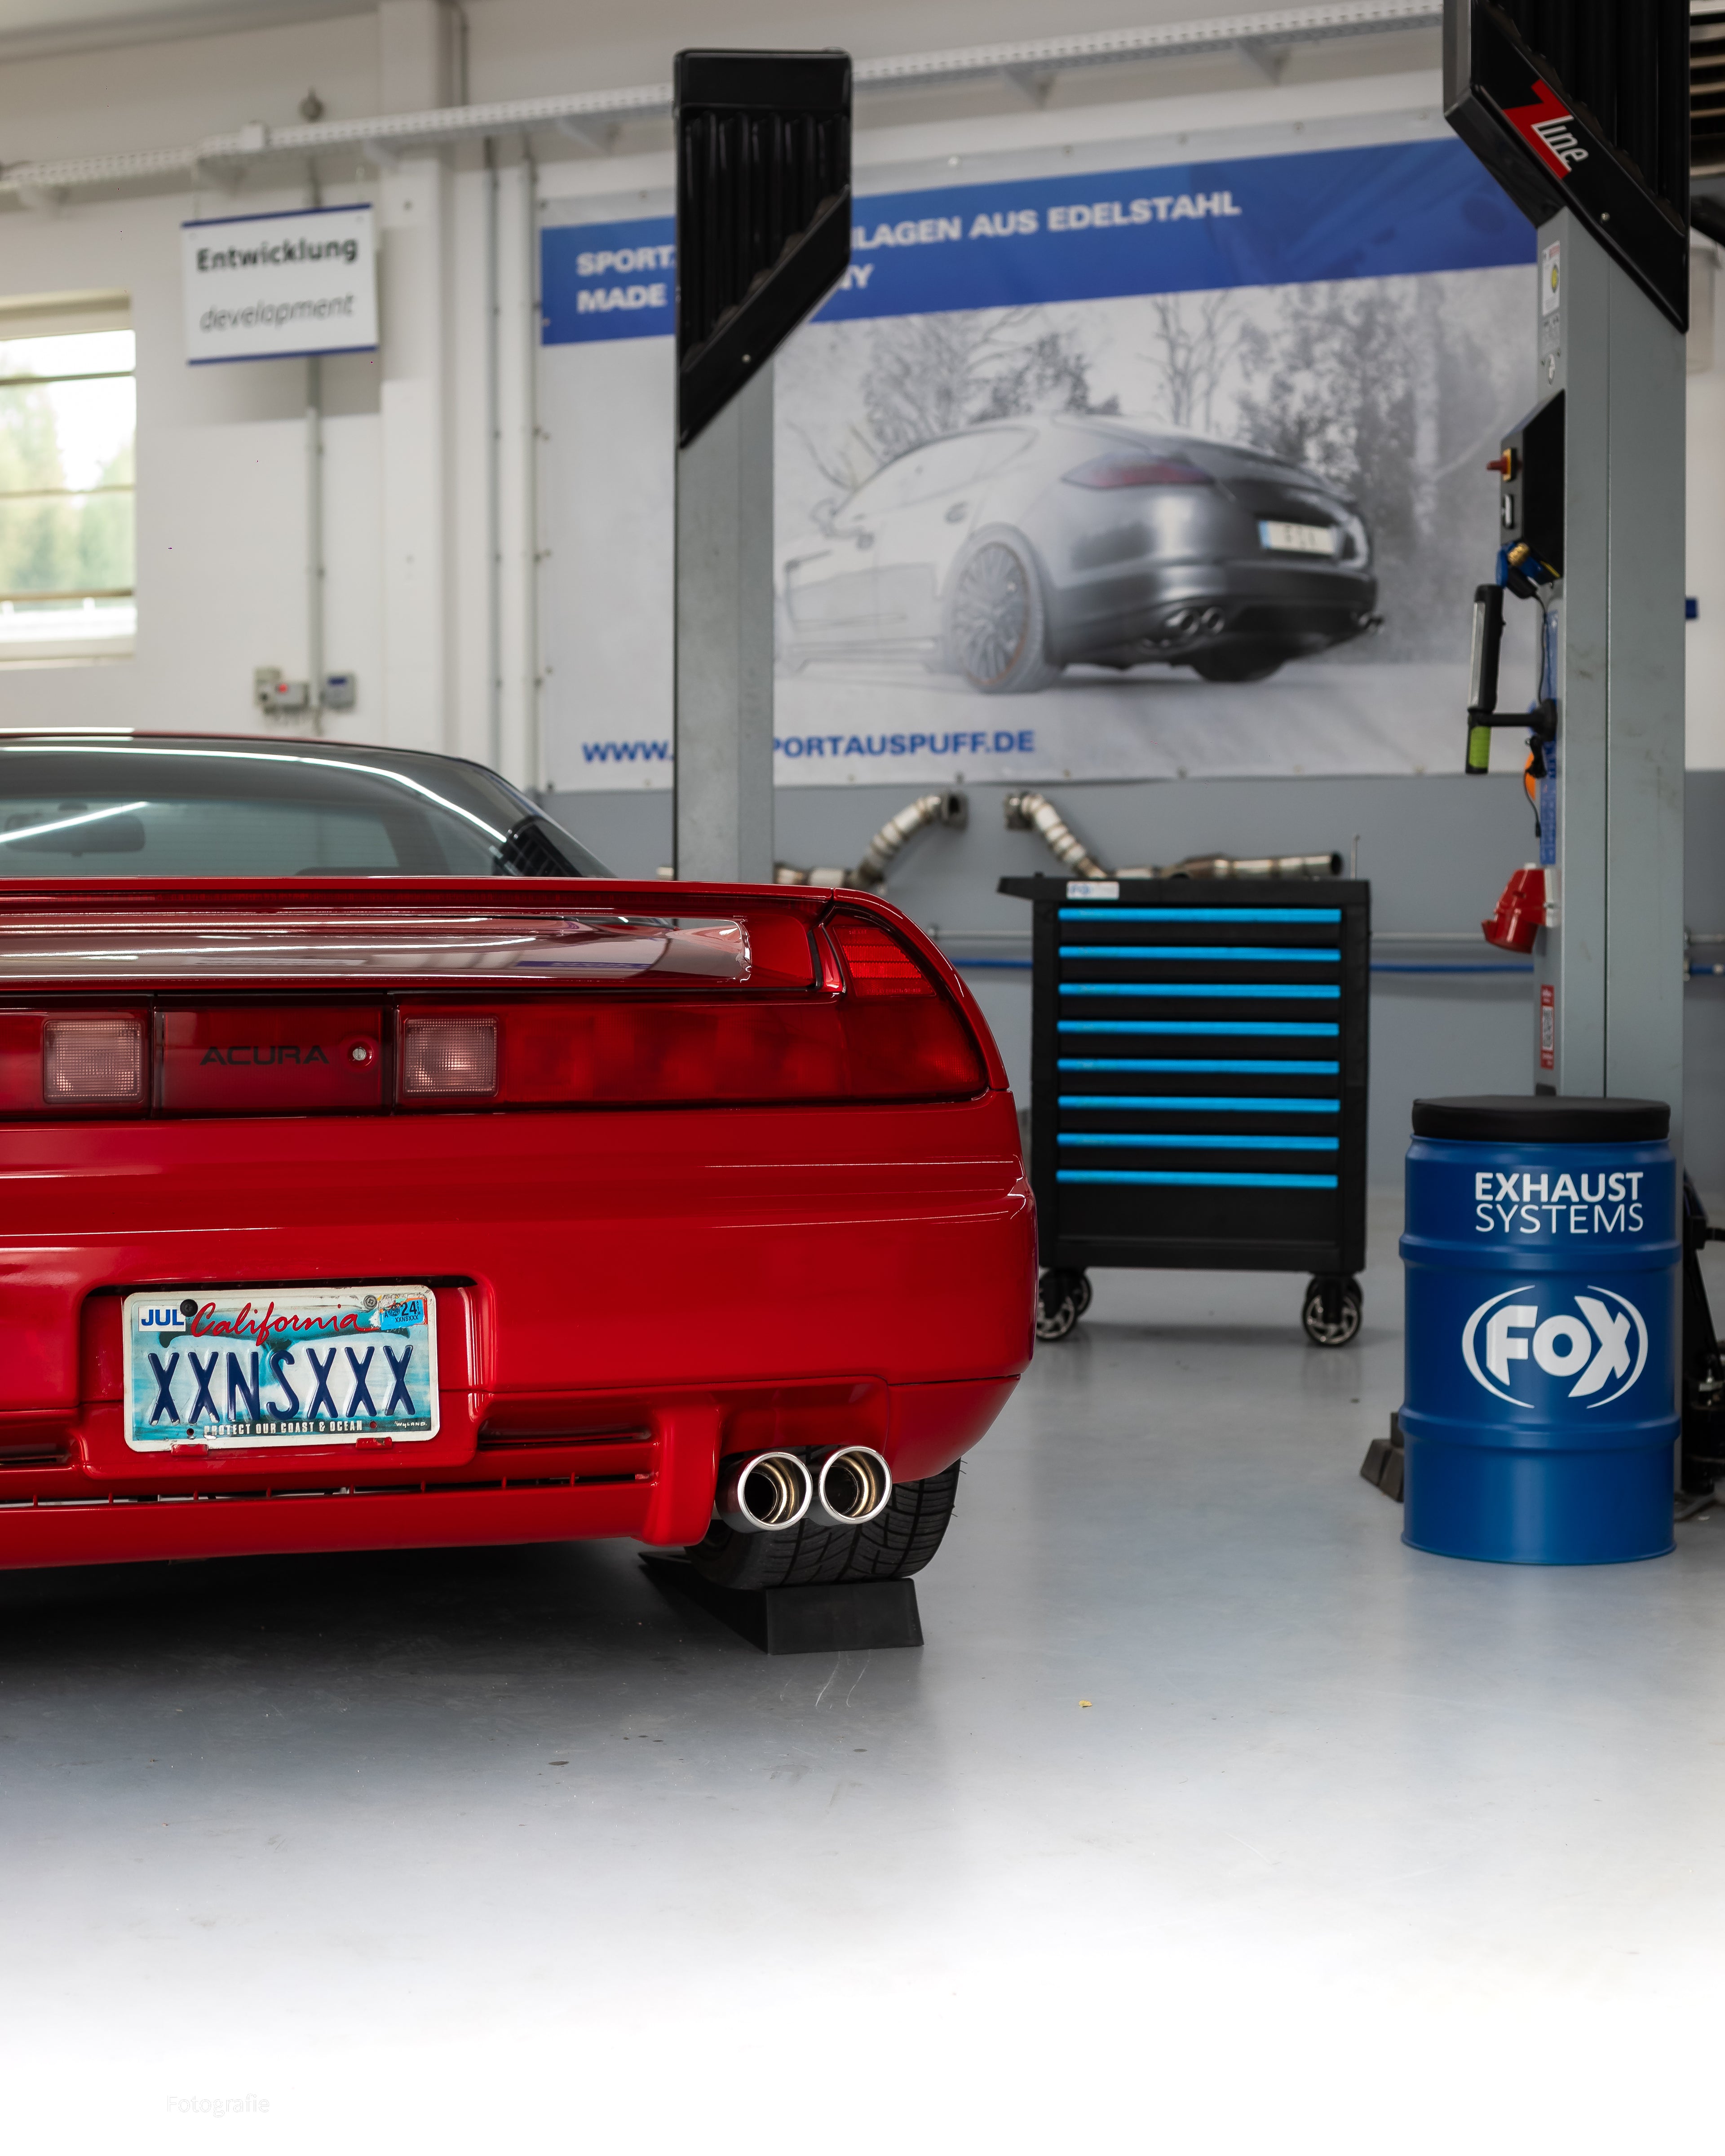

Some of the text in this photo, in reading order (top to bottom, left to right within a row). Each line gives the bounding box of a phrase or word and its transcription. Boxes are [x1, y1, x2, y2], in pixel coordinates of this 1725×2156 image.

[576, 191, 1241, 277] SPORT LAGEN AUS EDELSTAHL
[197, 237, 358, 272] Entwicklung
[199, 294, 354, 332] development
[577, 283, 668, 314] MADE
[199, 1046, 330, 1065] ACURA
[1475, 1172, 1644, 1202] EXHAUST
[1475, 1203, 1644, 1233] SYSTEMS
[141, 1309, 184, 1326] JUL
[190, 1302, 379, 1346] California
[395, 1315, 419, 1323] XXNSXXX
[400, 1301, 417, 1317] 24
[148, 1345, 416, 1426] XXNSXXX
[204, 1420, 363, 1436] PROTECT OUR COAST & OCEAN
